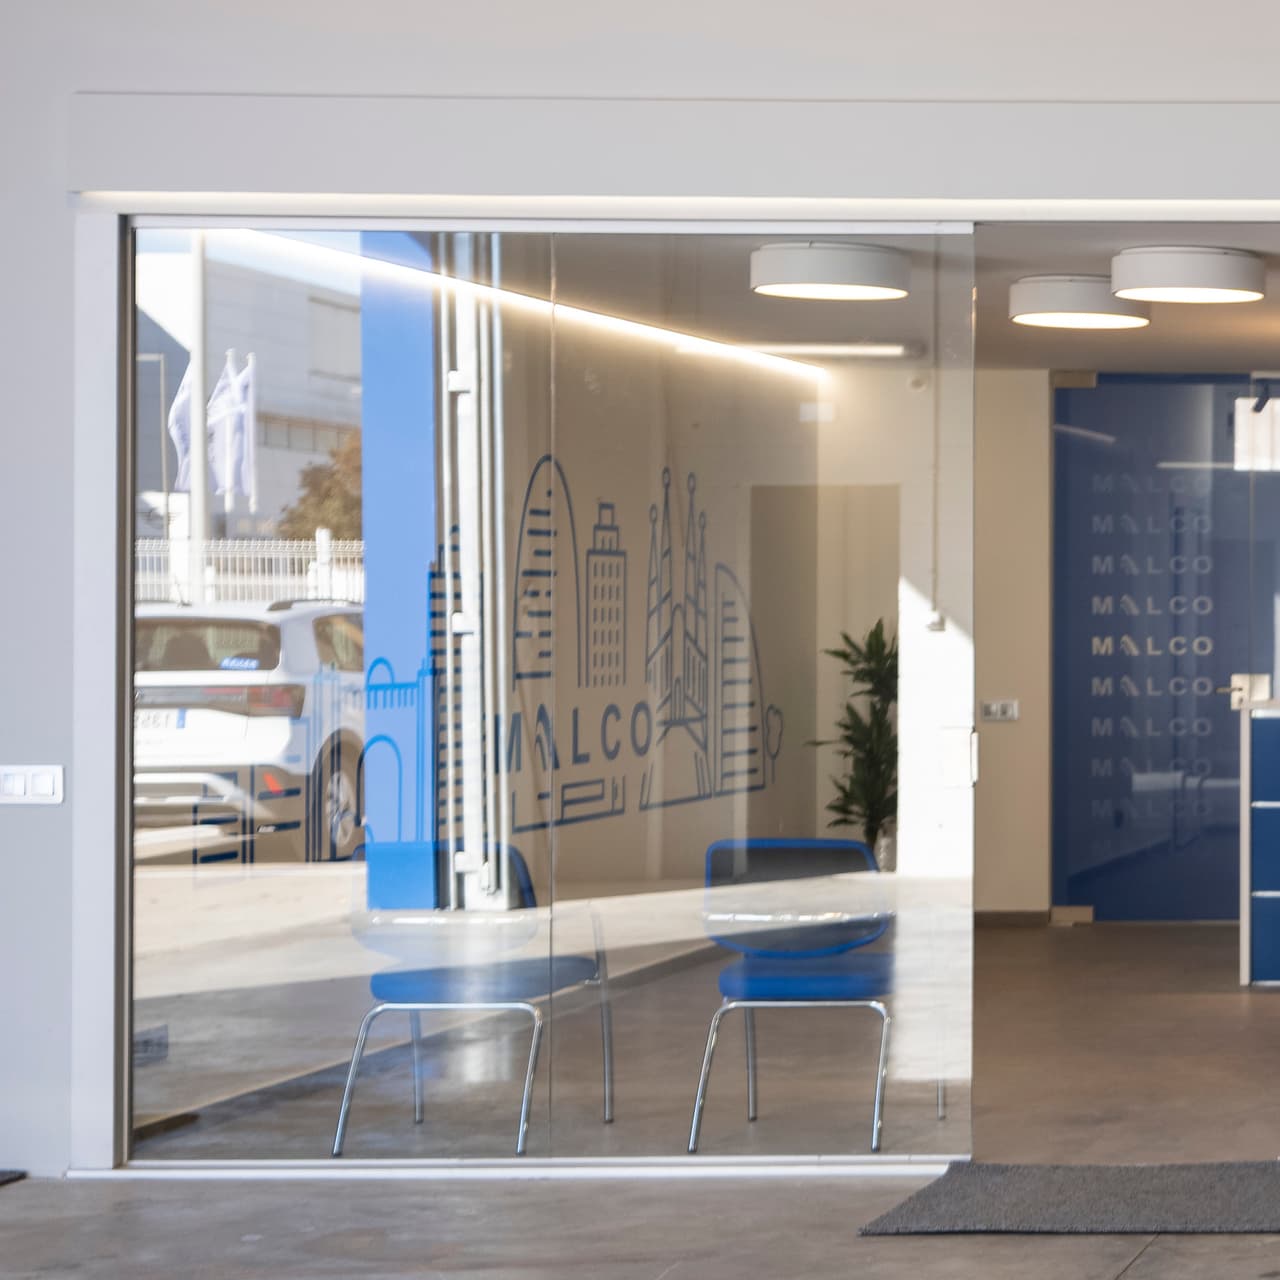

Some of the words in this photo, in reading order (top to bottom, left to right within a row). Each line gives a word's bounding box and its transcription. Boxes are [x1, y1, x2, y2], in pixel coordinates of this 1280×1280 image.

[1092, 594, 1213, 616] MALCO
[1092, 634, 1213, 657] MALCO
[1092, 675, 1213, 697] MALCO
